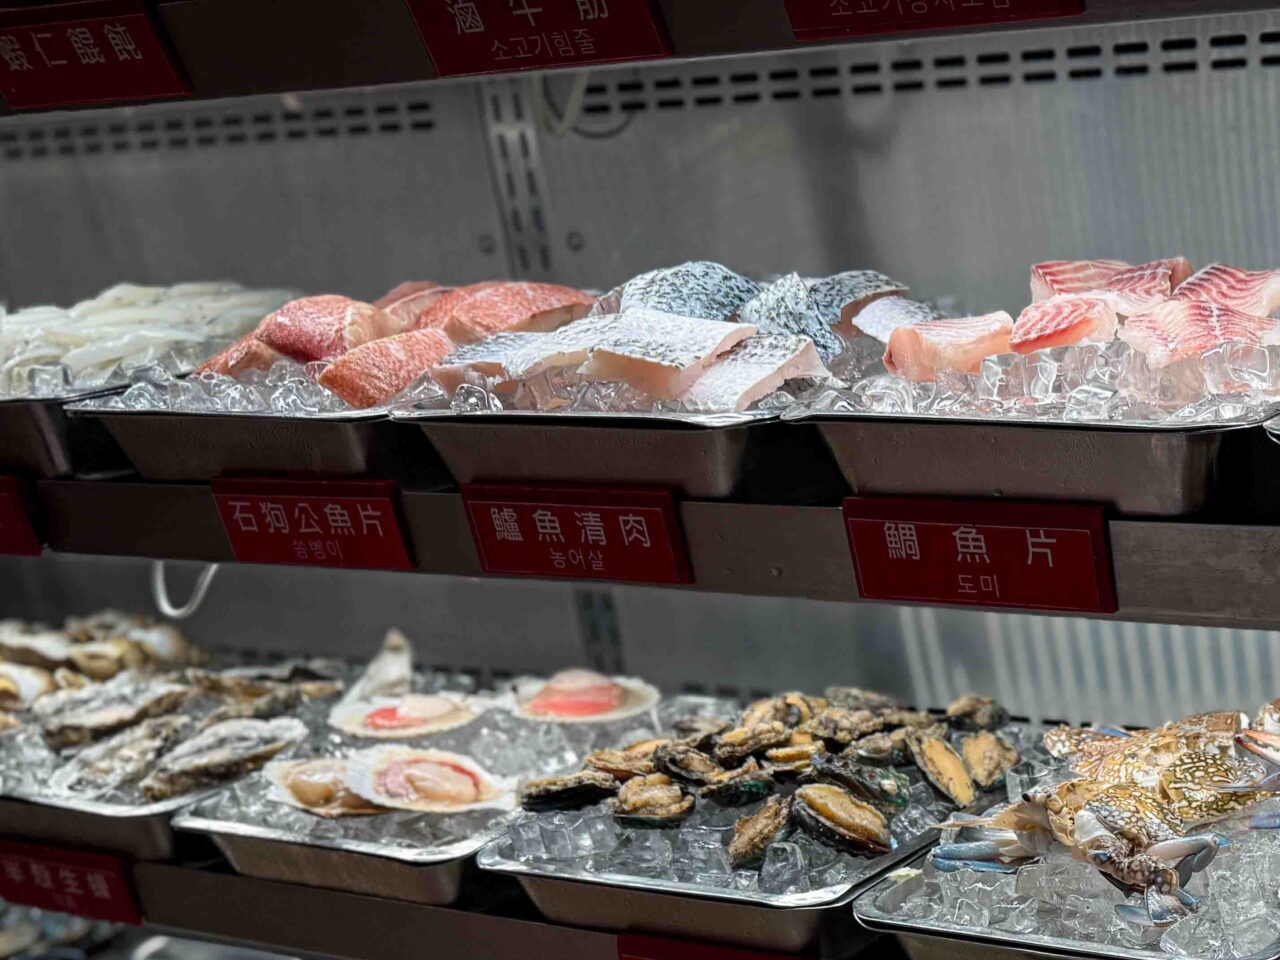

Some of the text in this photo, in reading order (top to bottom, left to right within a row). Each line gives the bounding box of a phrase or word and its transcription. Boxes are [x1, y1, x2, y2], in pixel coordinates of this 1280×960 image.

[491, 29, 597, 60] 소고기힘줄
[228, 501, 384, 537] 石狗公魚片
[490, 506, 651, 548] 鱸魚清肉
[550, 547, 605, 572] 농어살
[883, 521, 1057, 568] 鯛魚片
[957, 573, 999, 598] 도미
